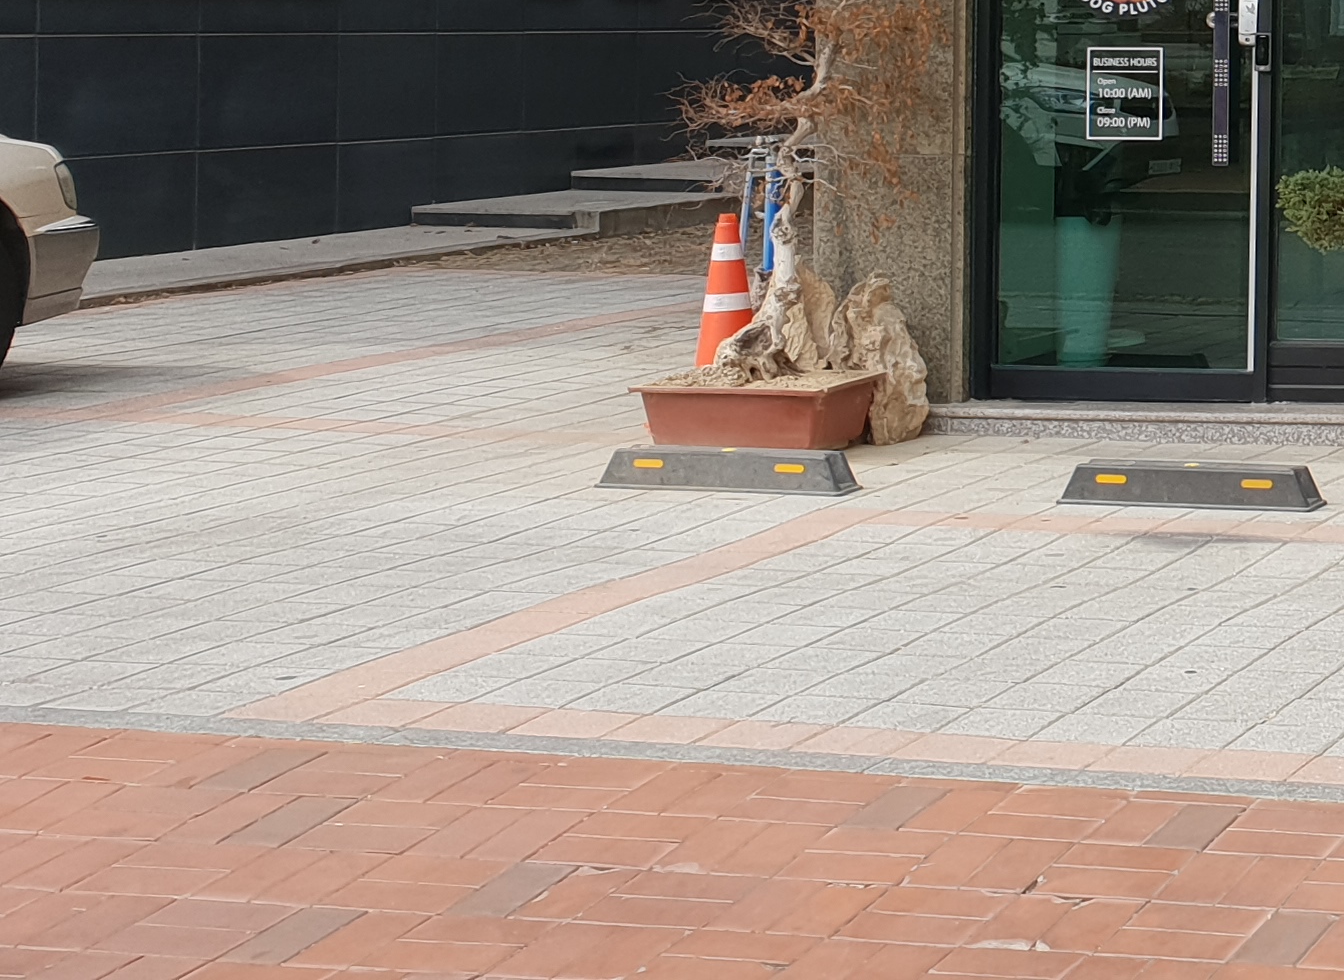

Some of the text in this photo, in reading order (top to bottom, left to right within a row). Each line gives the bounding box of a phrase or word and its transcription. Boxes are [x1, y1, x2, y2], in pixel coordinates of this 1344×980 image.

[1093, 57, 1158, 67] BUSINESS HOURS
[1097, 77, 1117, 86] Open
[1098, 87, 1152, 100] 10:00 (AM)
[1096, 106, 1116, 114] Close
[1096, 116, 1151, 128] 09:00 (PM)
